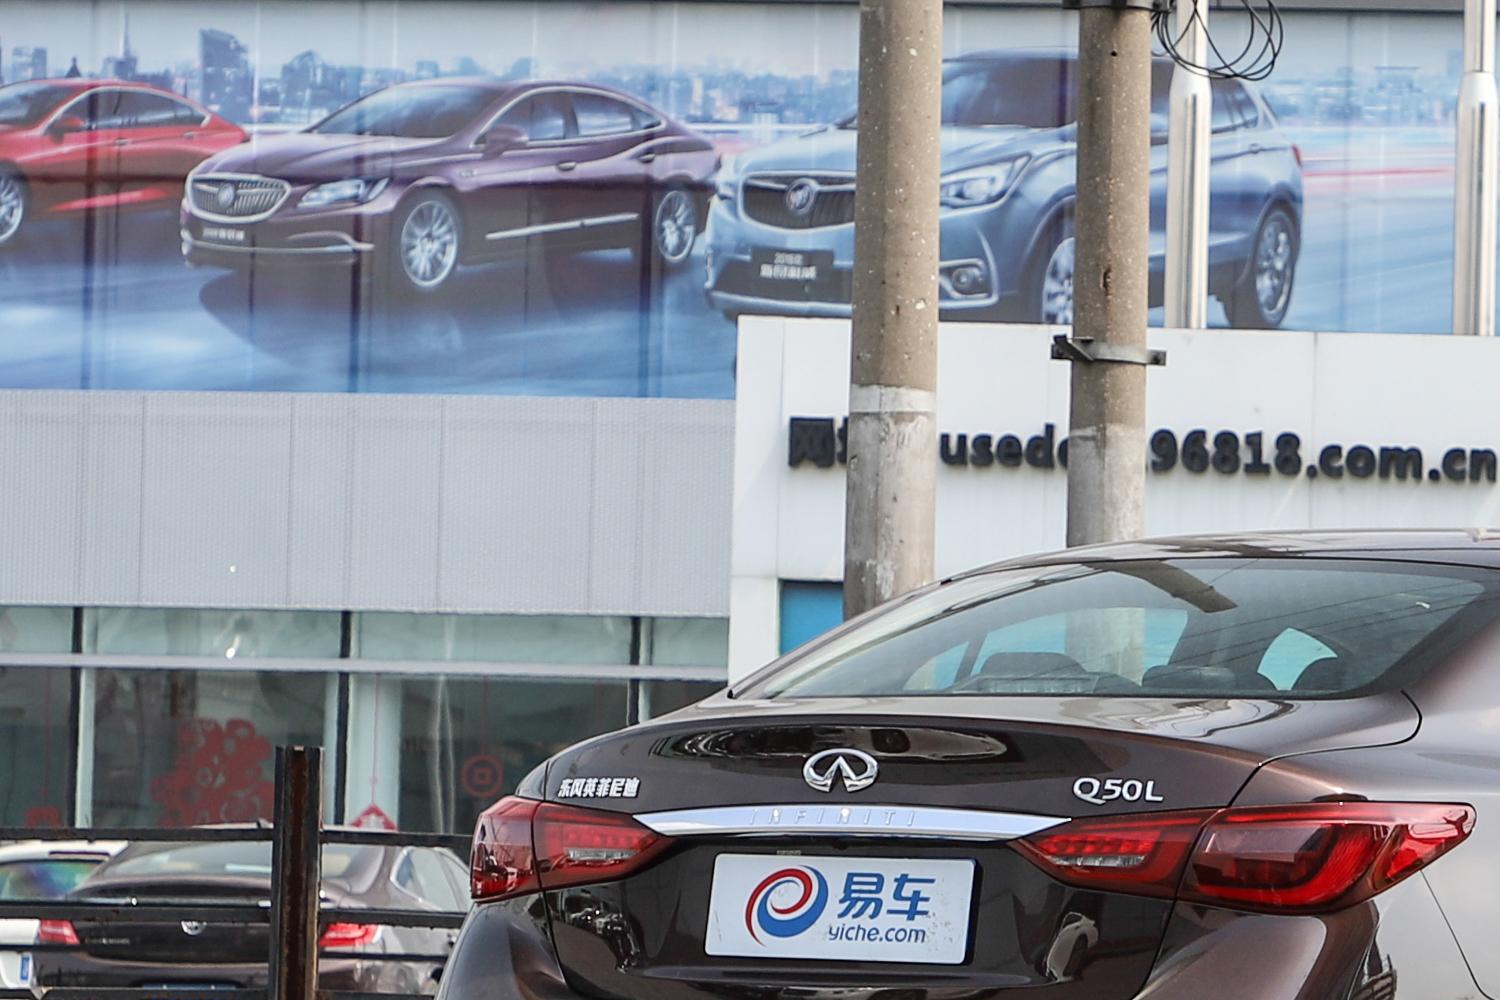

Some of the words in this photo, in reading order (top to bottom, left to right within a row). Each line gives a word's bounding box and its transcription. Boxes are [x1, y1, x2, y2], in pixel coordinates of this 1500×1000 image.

[557, 777, 640, 798] 东风英菲尼迪
[1073, 776, 1164, 805] Q50L
[750, 808, 916, 827] INFINITI
[837, 872, 937, 921] 易车
[828, 923, 926, 943] yiche.com
